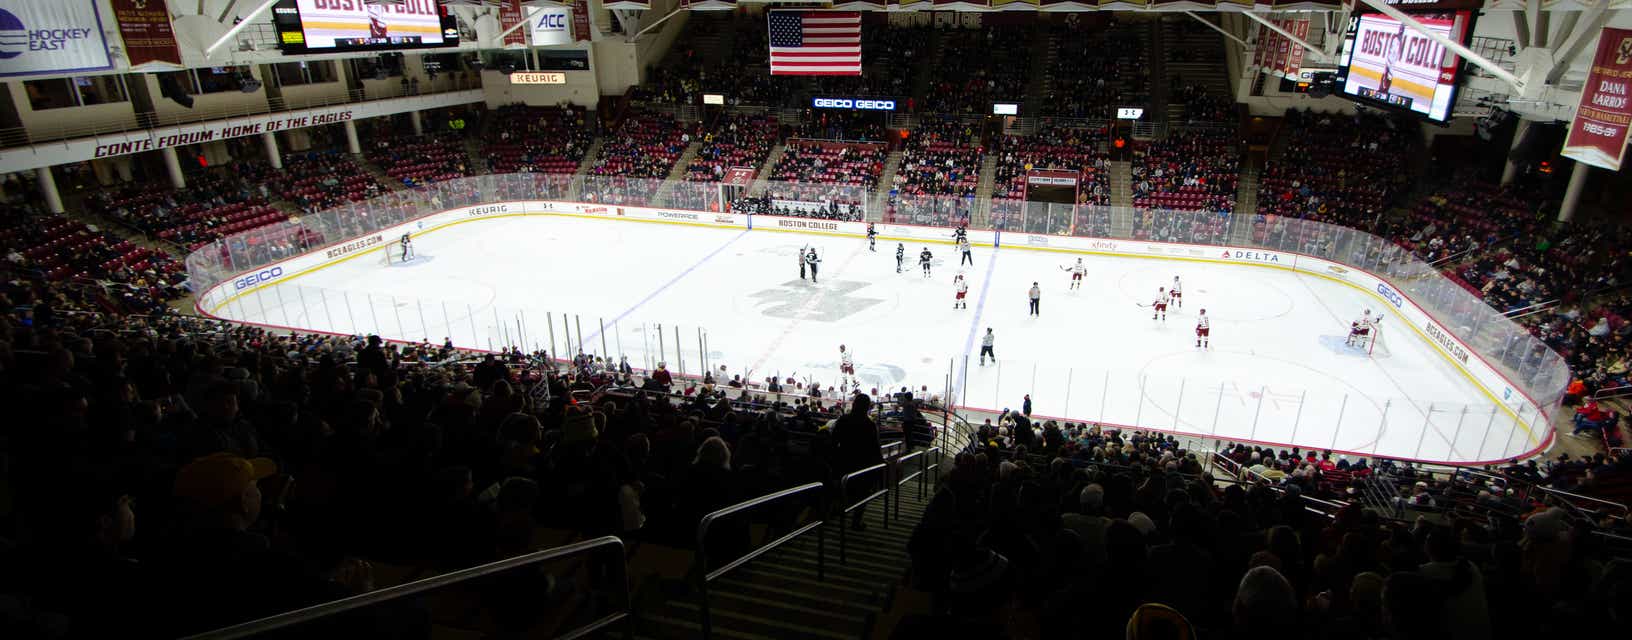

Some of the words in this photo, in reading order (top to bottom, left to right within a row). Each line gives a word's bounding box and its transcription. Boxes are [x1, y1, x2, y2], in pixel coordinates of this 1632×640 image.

[537, 14, 565, 28] ACC
[29, 28, 91, 40] HOCKEY
[28, 39, 67, 51] EAST
[516, 74, 558, 83] KEURIG
[1600, 80, 1625, 95] DANA
[814, 98, 853, 108] GEICO
[855, 99, 894, 110] GEICO
[95, 138, 153, 158] CONTE
[158, 131, 214, 149] FORUM
[222, 123, 261, 138] HOME
[266, 120, 283, 132] OF
[286, 116, 308, 129] THE
[311, 110, 353, 125] EAGLES
[468, 204, 508, 216] KEURIG
[778, 219, 807, 228] BOSTON
[808, 221, 838, 230] COLLEGE
[326, 234, 384, 259] BCEAGLES.COM
[1091, 240, 1118, 251] xfinity
[1235, 250, 1280, 263] DELTA
[235, 266, 283, 290] GEICO
[1377, 284, 1403, 308] GEICO
[1425, 322, 1469, 364] BCEAGLES.COM
